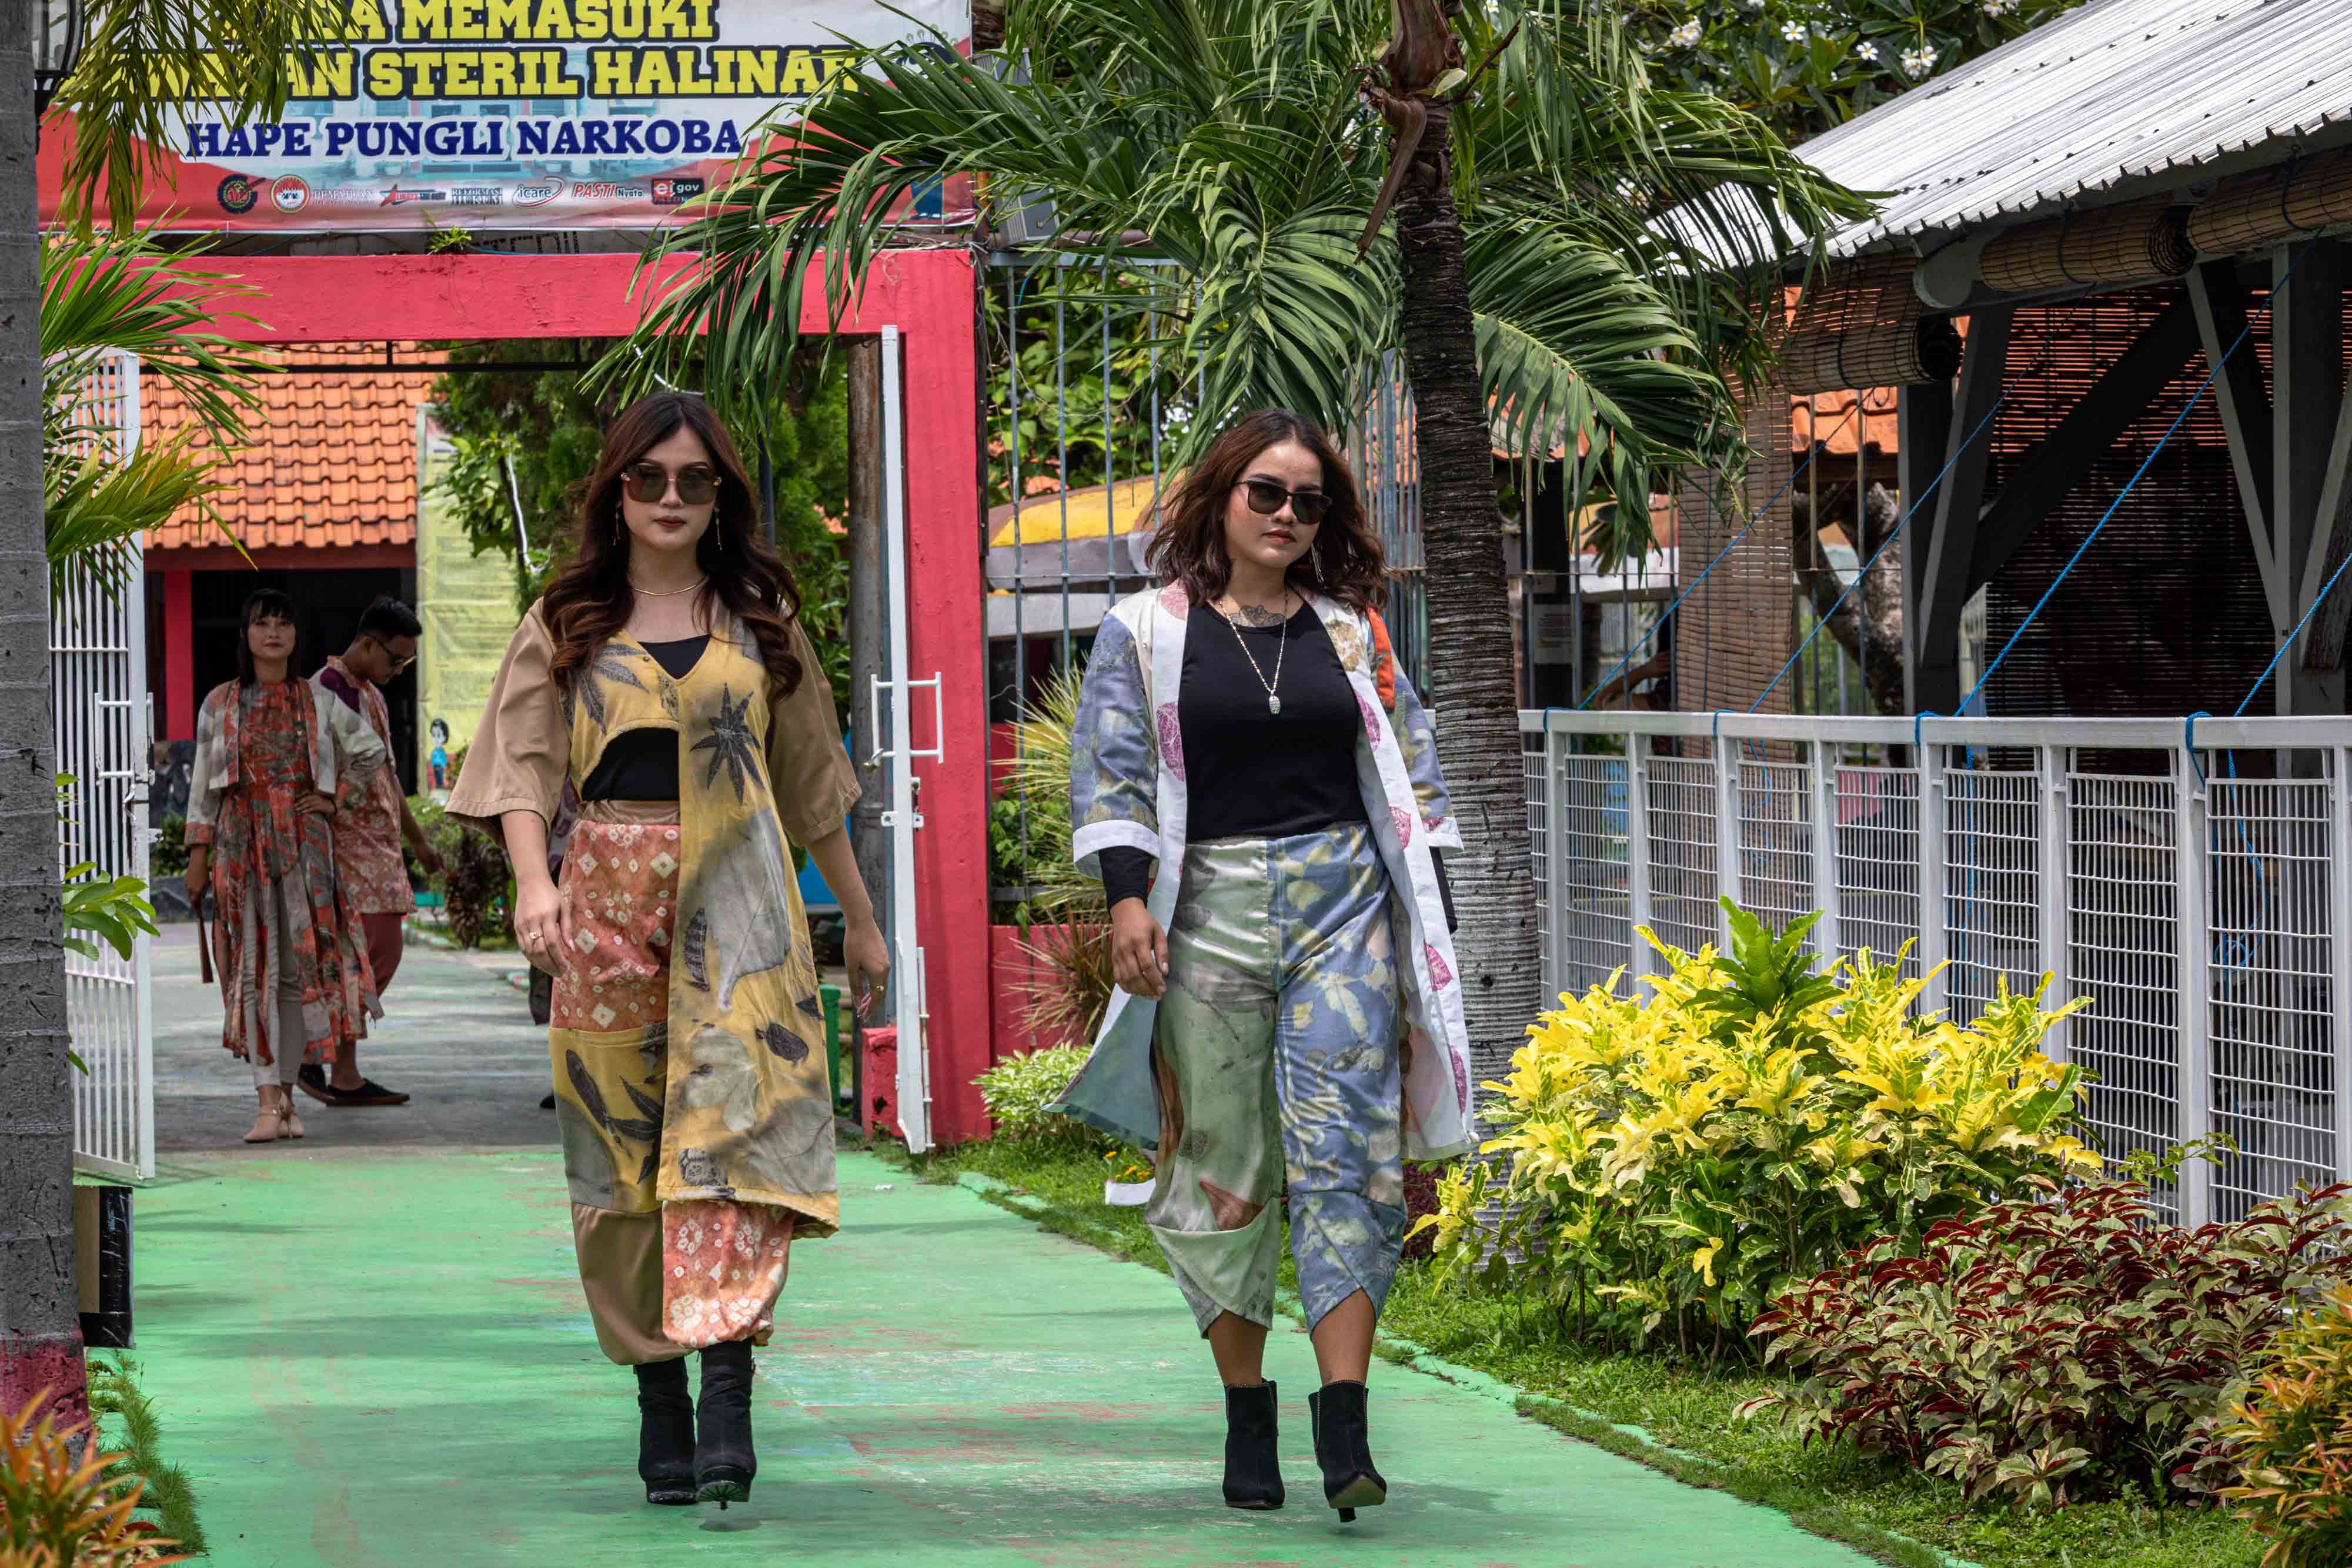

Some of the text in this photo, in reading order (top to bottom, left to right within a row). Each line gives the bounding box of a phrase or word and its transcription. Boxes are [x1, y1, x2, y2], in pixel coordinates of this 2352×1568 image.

[402, 0, 712, 39] MEMASUKI
[370, 51, 577, 96] STERIL
[186, 119, 741, 157] HAPE PUNGLI NARKOBA
[516, 184, 552, 198] icare
[573, 183, 616, 198] PASTI
[676, 183, 700, 193] gov
